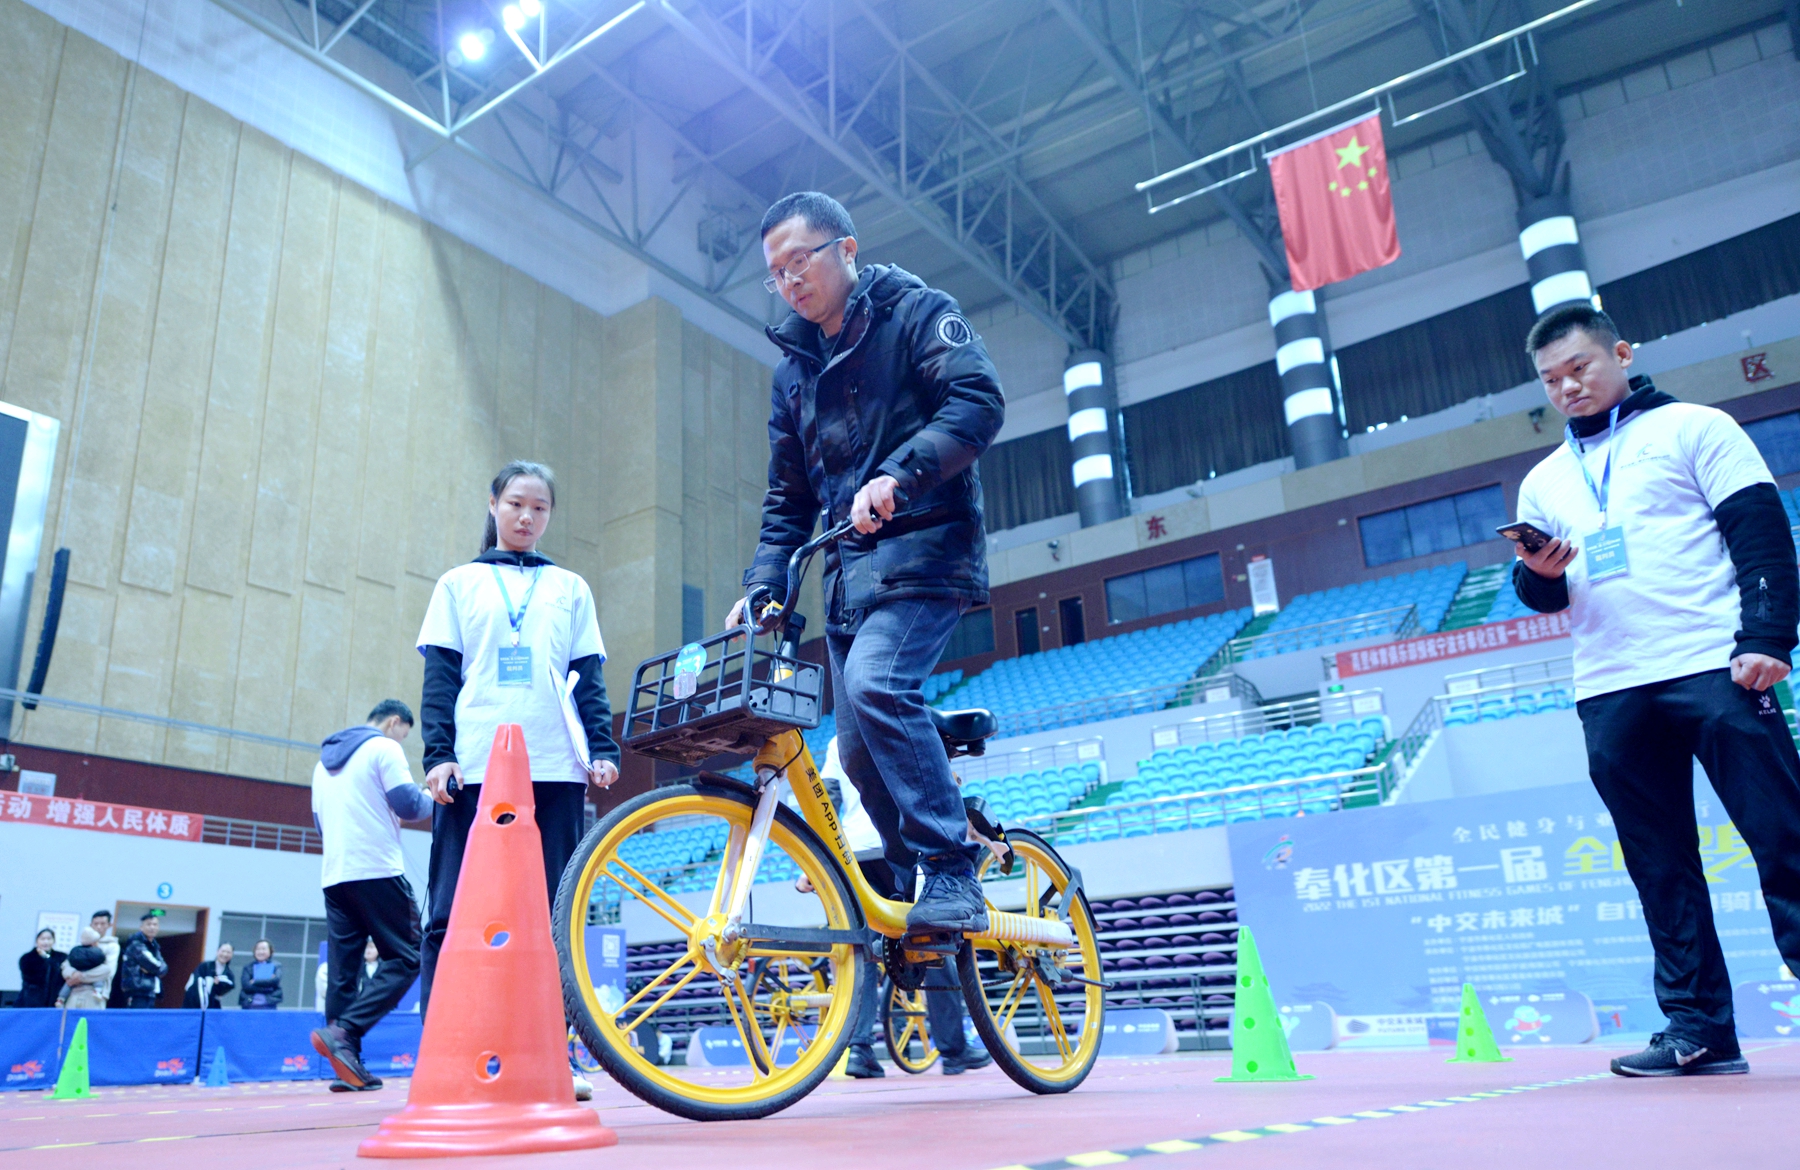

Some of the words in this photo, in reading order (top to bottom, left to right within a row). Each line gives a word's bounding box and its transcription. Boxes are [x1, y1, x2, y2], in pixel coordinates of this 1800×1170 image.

[1740, 353, 1773, 382] 区
[1146, 516, 1168, 540] 东
[0, 796, 33, 819] 动
[46, 801, 190, 837] 增强人民体质
[1293, 845, 1548, 901] 奉化区第一届
[159, 883, 171, 898] 3
[1385, 891, 1444, 906] NATIONAL
[1448, 886, 1503, 901] FITNESS
[1505, 880, 1554, 896] GAMES
[1558, 880, 1575, 892] OF
